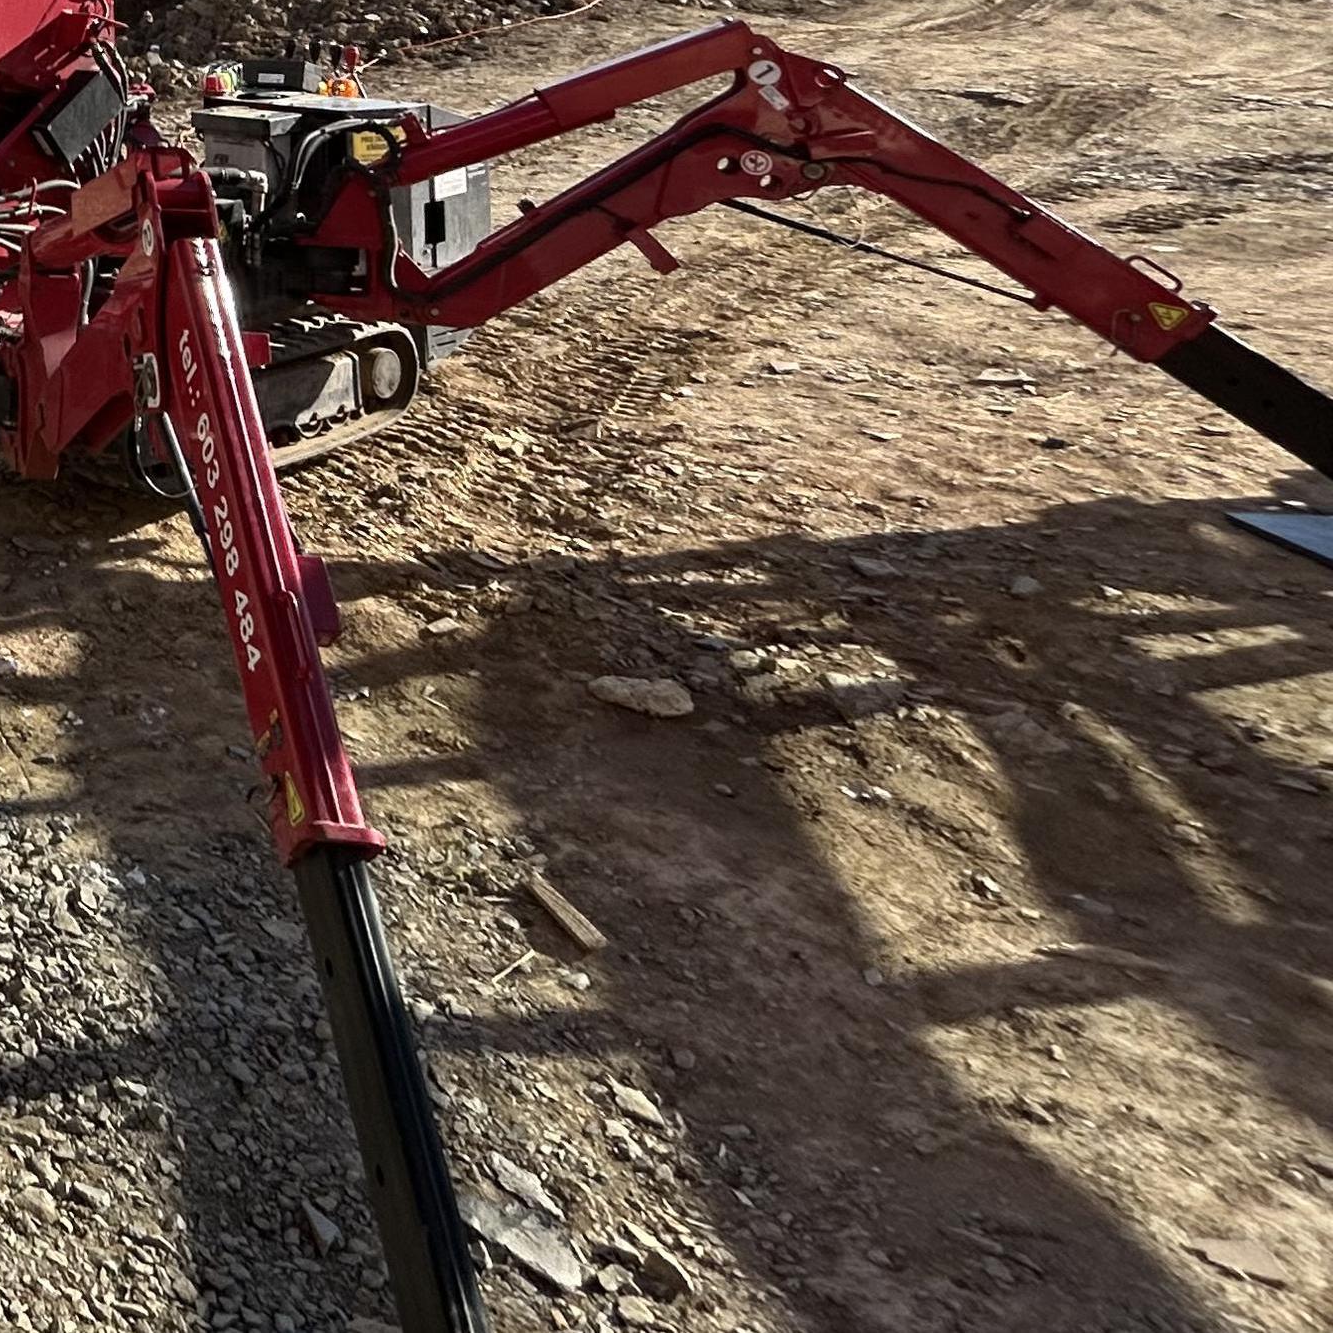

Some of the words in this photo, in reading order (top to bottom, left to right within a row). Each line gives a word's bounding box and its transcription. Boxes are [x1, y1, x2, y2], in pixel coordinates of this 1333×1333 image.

[755, 64, 774, 79] 1
[179, 329, 200, 407] tel.:
[197, 412, 220, 489] 603
[214, 495, 239, 577] 298
[235, 589, 261, 672] 484
